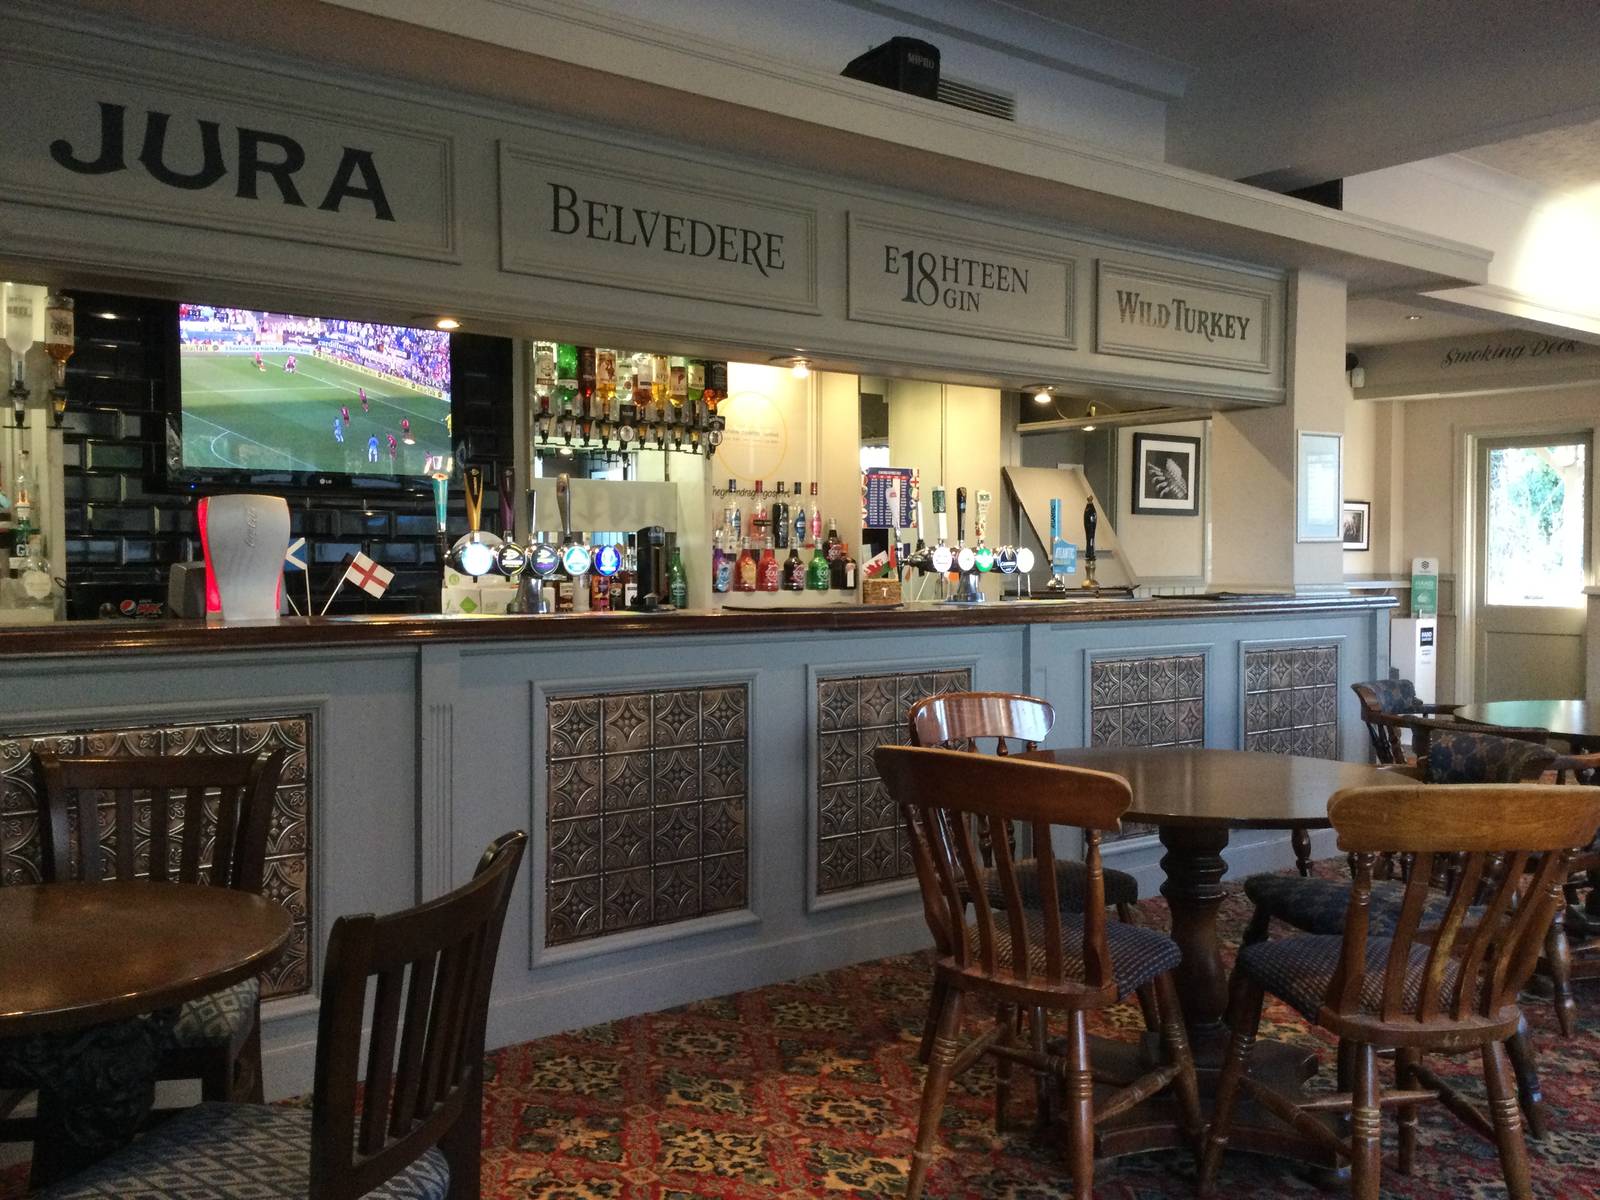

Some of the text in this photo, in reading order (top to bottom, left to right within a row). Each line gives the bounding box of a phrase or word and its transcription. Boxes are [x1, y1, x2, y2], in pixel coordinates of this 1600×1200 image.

[50, 101, 396, 222] JURA
[547, 182, 786, 278] BELVEDERE
[943, 288, 981, 312] GIN
[1172, 298, 1250, 343] TURKEY
[1440, 344, 1526, 369] Smoking
